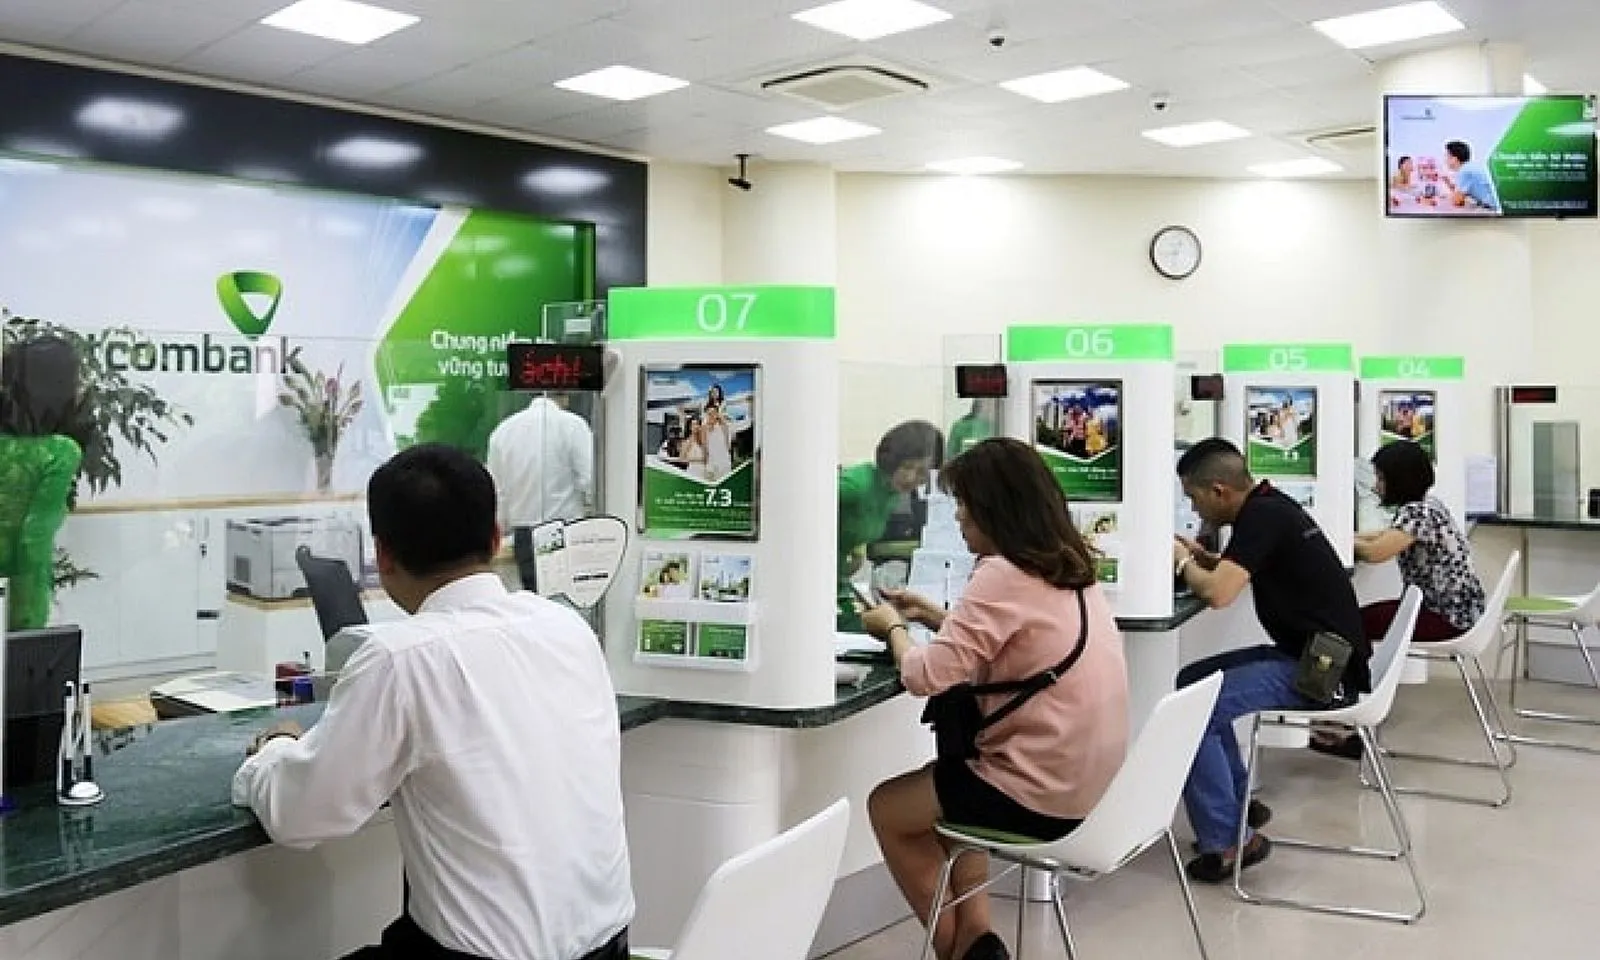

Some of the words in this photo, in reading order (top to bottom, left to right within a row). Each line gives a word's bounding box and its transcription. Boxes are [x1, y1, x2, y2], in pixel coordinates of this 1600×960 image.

[696, 293, 757, 332] 07
[86, 333, 304, 375] tcombank
[431, 330, 488, 355] Chung
[1065, 328, 1114, 358] 06
[1269, 347, 1308, 371] 05
[1397, 356, 1430, 378] 04
